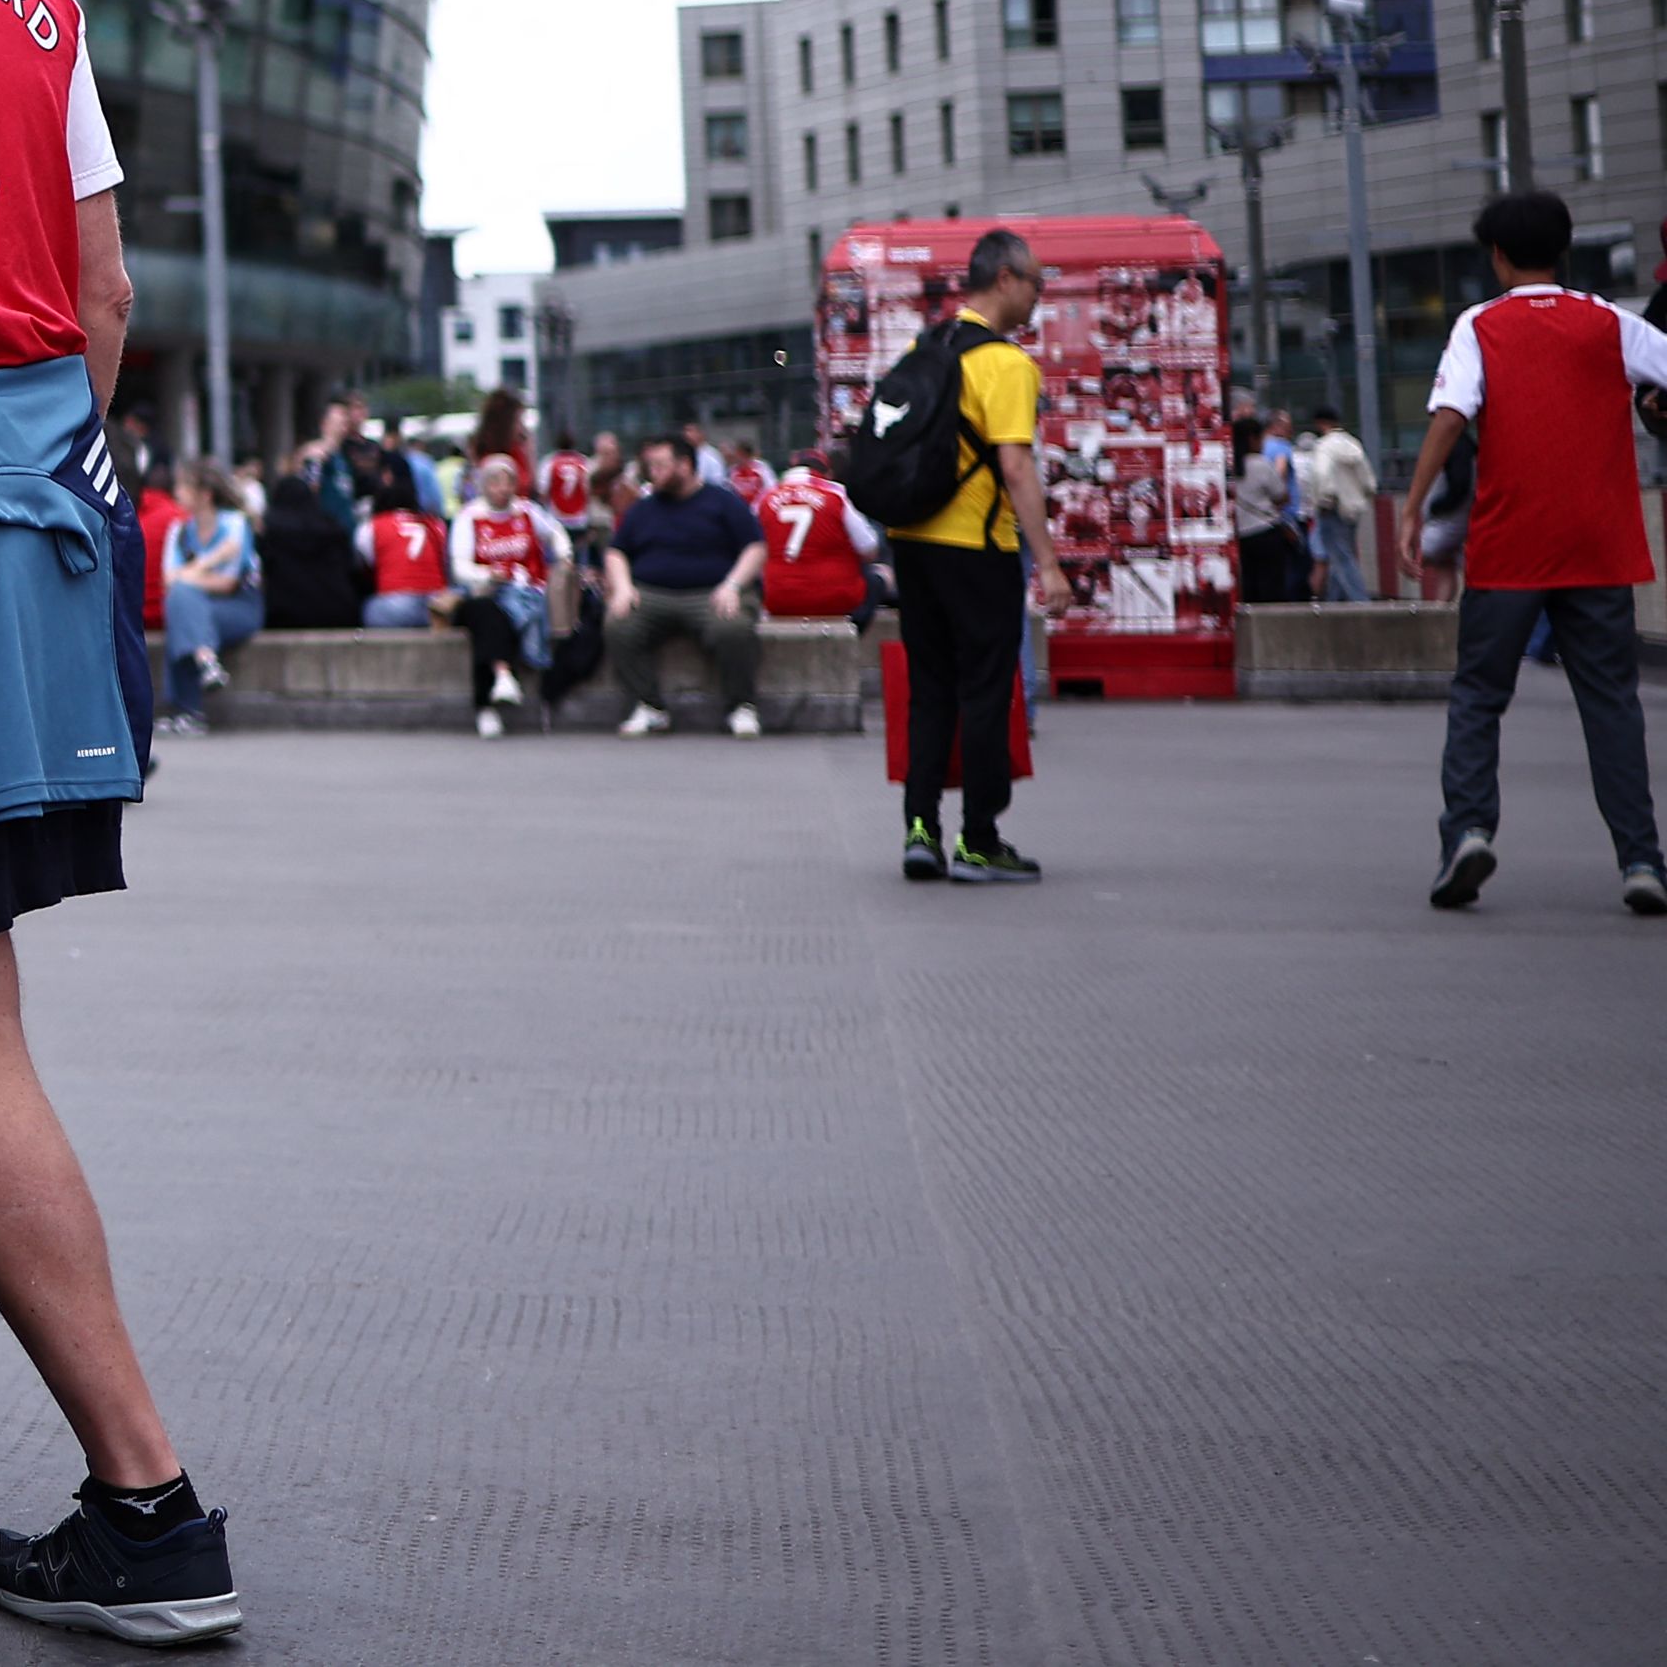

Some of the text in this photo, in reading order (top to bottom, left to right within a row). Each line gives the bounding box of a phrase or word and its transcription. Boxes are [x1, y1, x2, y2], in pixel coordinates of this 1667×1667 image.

[397, 522, 429, 561] 7
[776, 506, 814, 560] 7
[76, 746, 116, 758] AEROREADY
